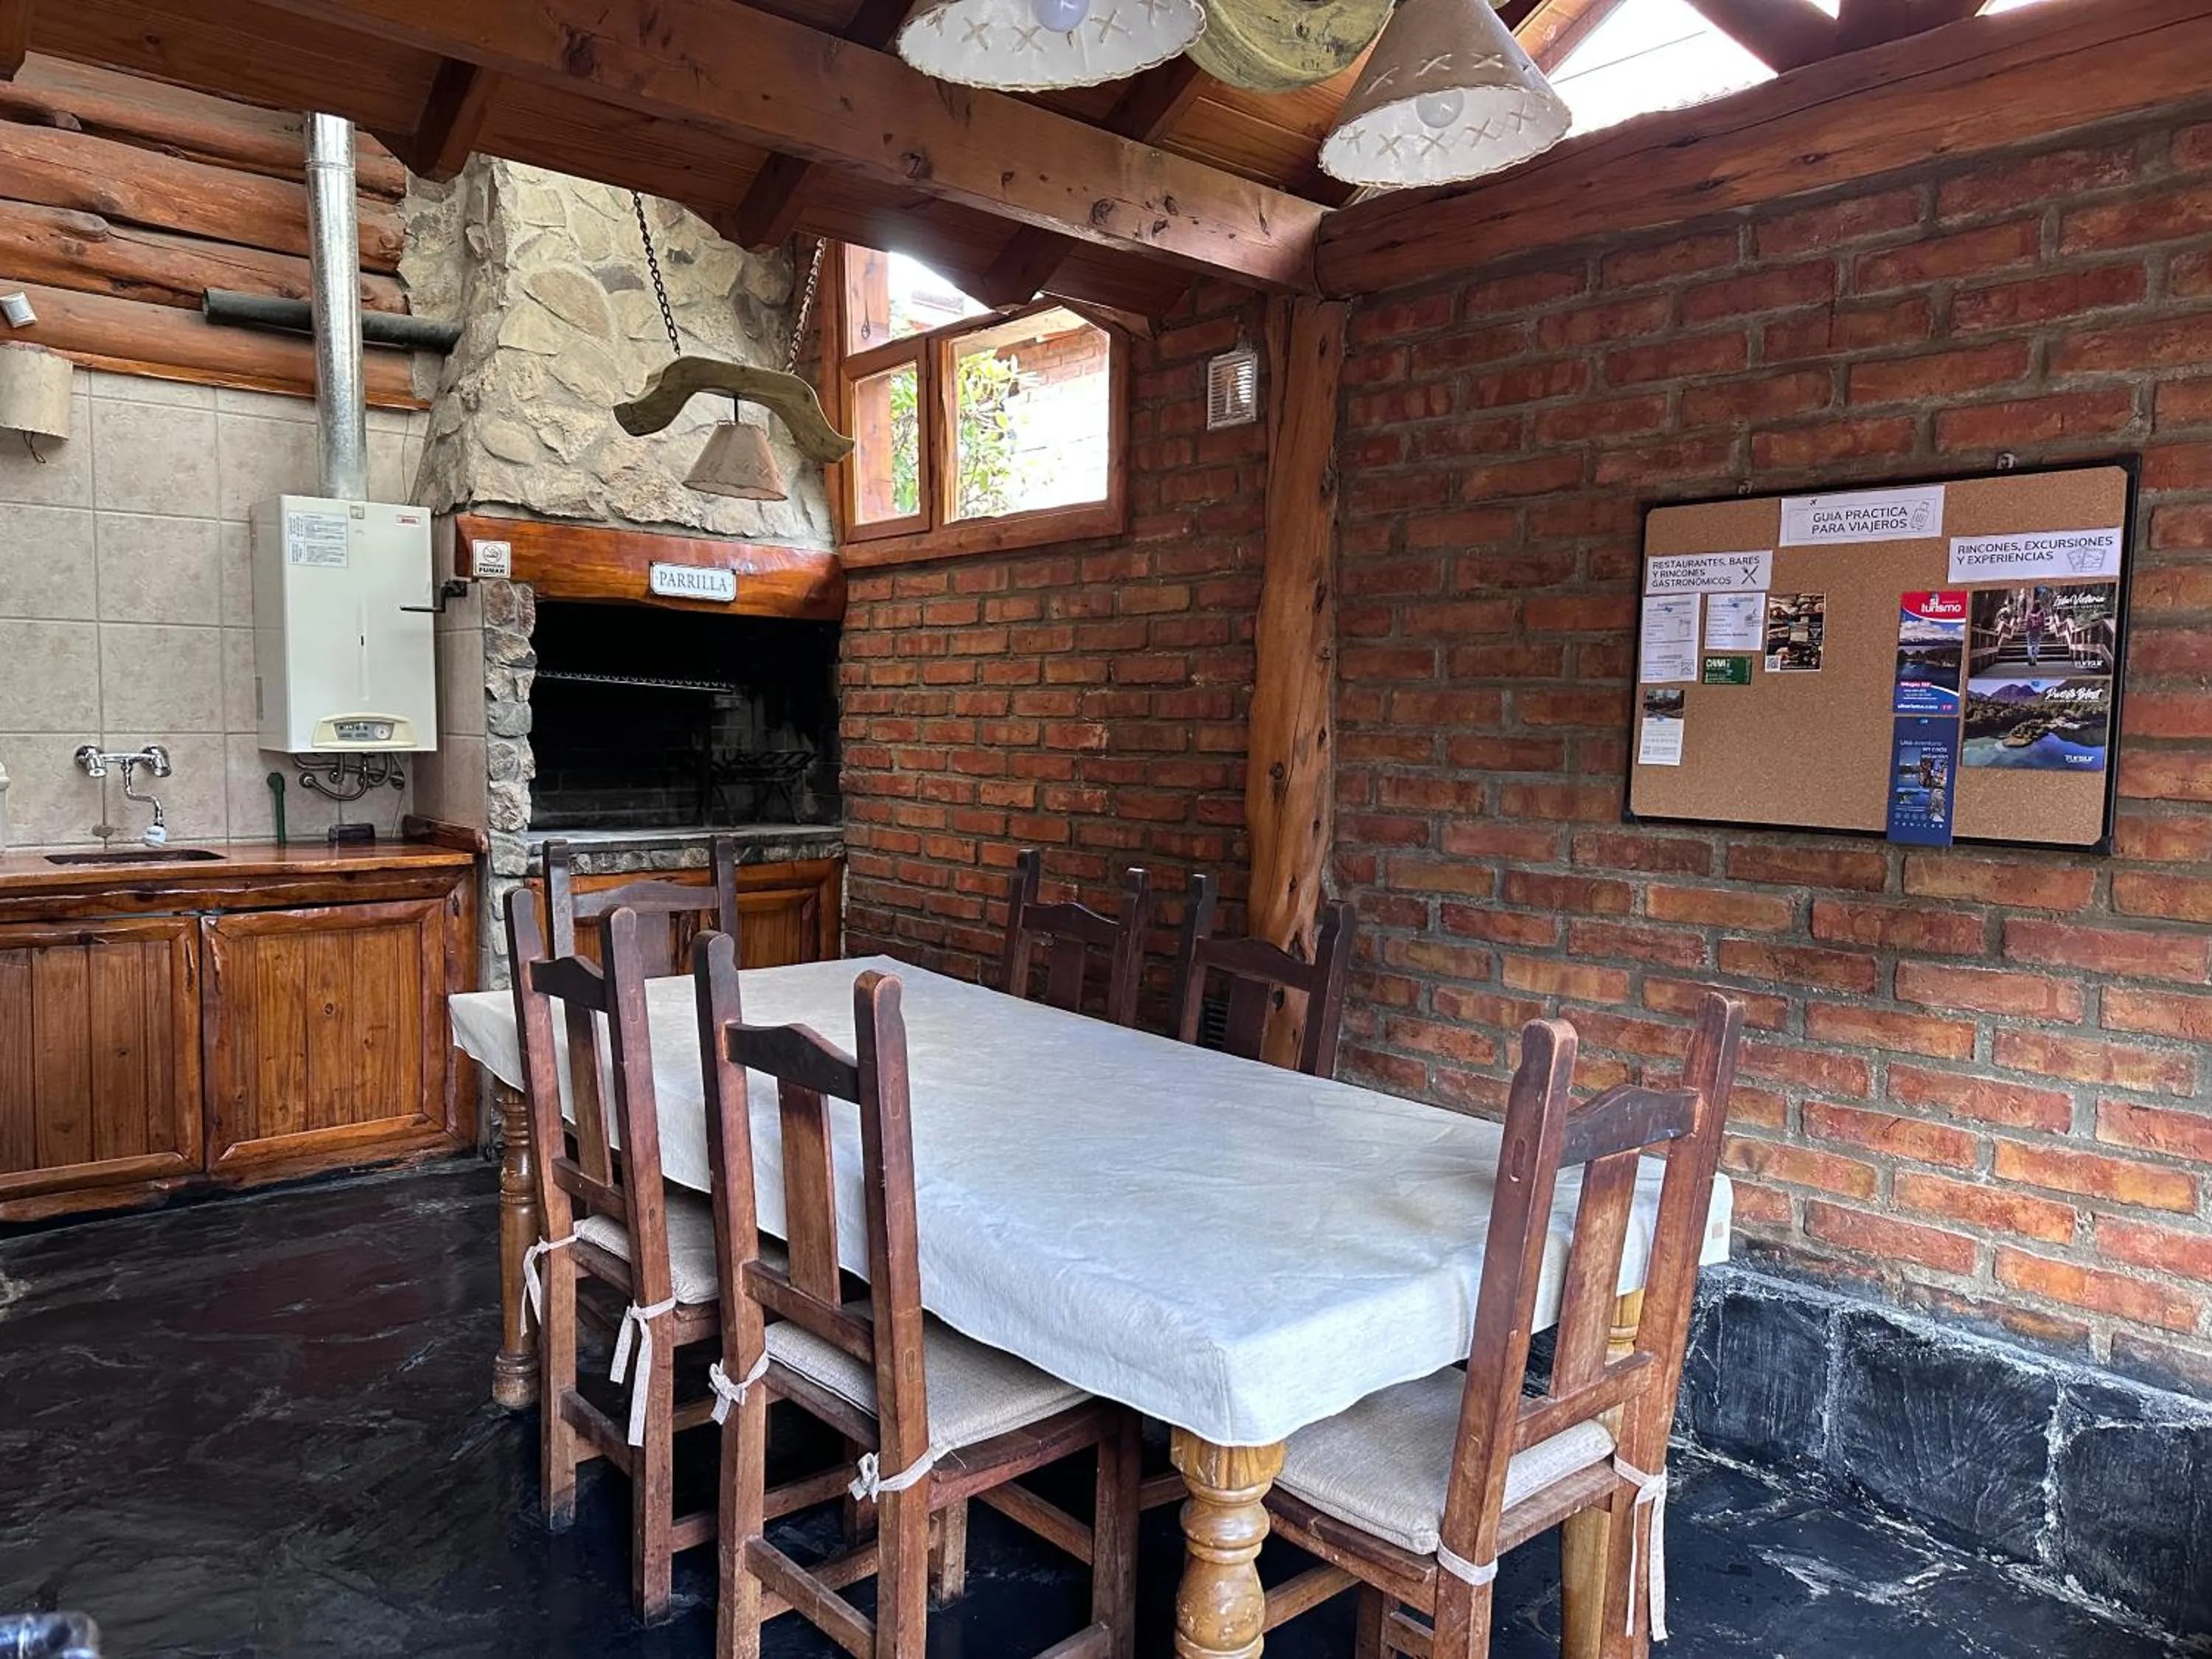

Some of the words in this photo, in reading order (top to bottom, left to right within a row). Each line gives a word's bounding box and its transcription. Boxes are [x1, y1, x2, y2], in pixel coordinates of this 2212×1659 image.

[1813, 512, 1843, 523] GUIA
[1846, 507, 1907, 520] PRACTICA
[1812, 524, 1845, 534] PARA
[1849, 518, 1907, 532] VIAJEROS
[1958, 541, 2021, 554] RINCONES,
[2025, 536, 2113, 551] EXCURSIONES
[1729, 556, 1760, 566] BARES
[1957, 557, 1964, 565] Y
[1967, 552, 2053, 565] EXPERIENCIAS
[1660, 568, 1705, 578] RINCONES
[660, 571, 727, 591] PARRILLA
[1921, 603, 1961, 613] turismo
